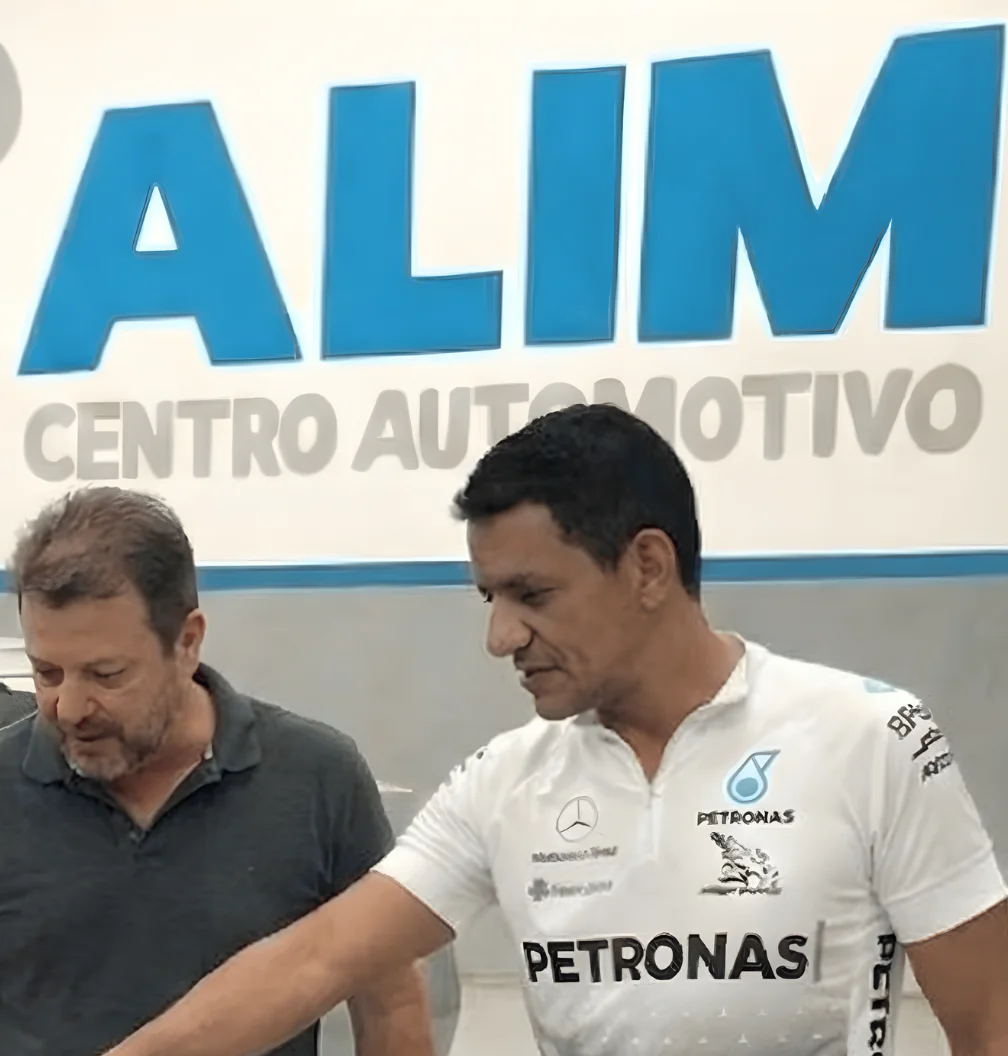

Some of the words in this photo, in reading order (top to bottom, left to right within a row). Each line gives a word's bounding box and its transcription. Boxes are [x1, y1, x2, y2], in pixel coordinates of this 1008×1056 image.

[17, 24, 1006, 376] ALIM
[23, 392, 338, 482] CENTRO
[351, 363, 982, 472] AUTOTIVO
[523, 932, 809, 981] PETRONAS
